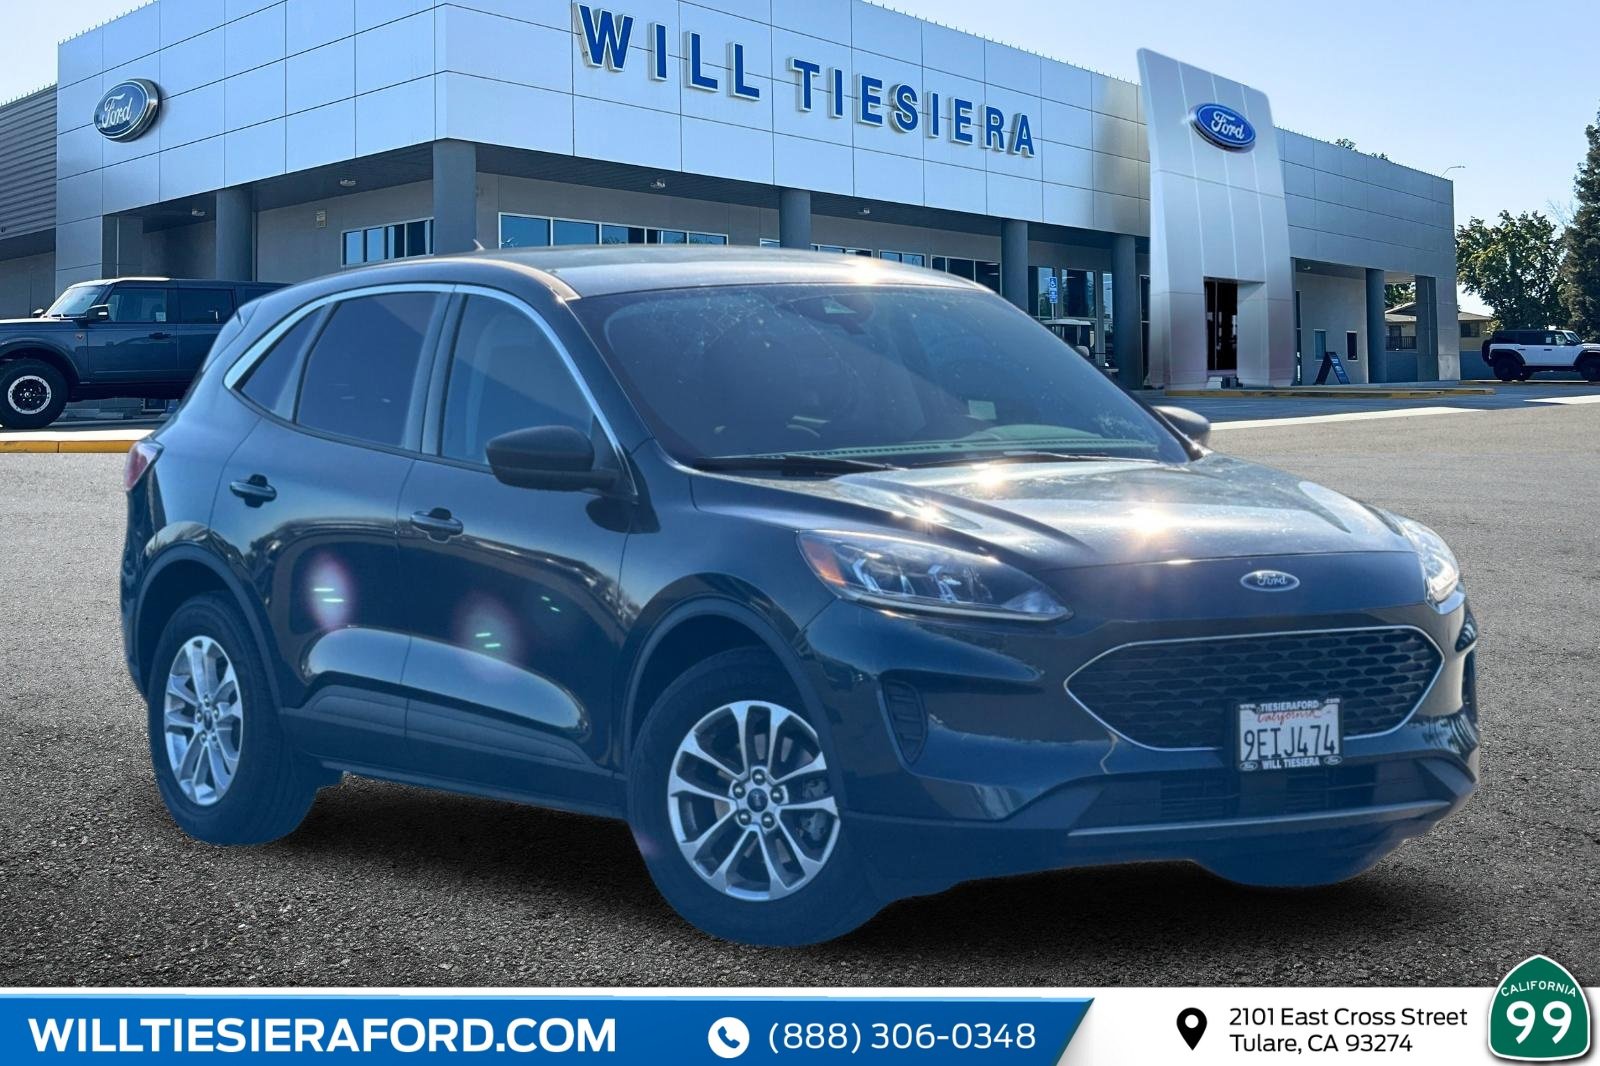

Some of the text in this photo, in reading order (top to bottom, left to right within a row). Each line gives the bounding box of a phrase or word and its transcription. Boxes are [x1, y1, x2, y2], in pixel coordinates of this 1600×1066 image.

[576, 3, 1035, 158] WILL TIESIERA
[101, 93, 133, 128] Ford
[1210, 110, 1244, 139] Ford
[1257, 573, 1288, 586] Ford
[1260, 700, 1319, 711] TIESIERAFORD
[1244, 724, 1335, 760] 9EIJ474
[1261, 760, 1281, 769] WILL
[1284, 757, 1320, 768] TIESIERA
